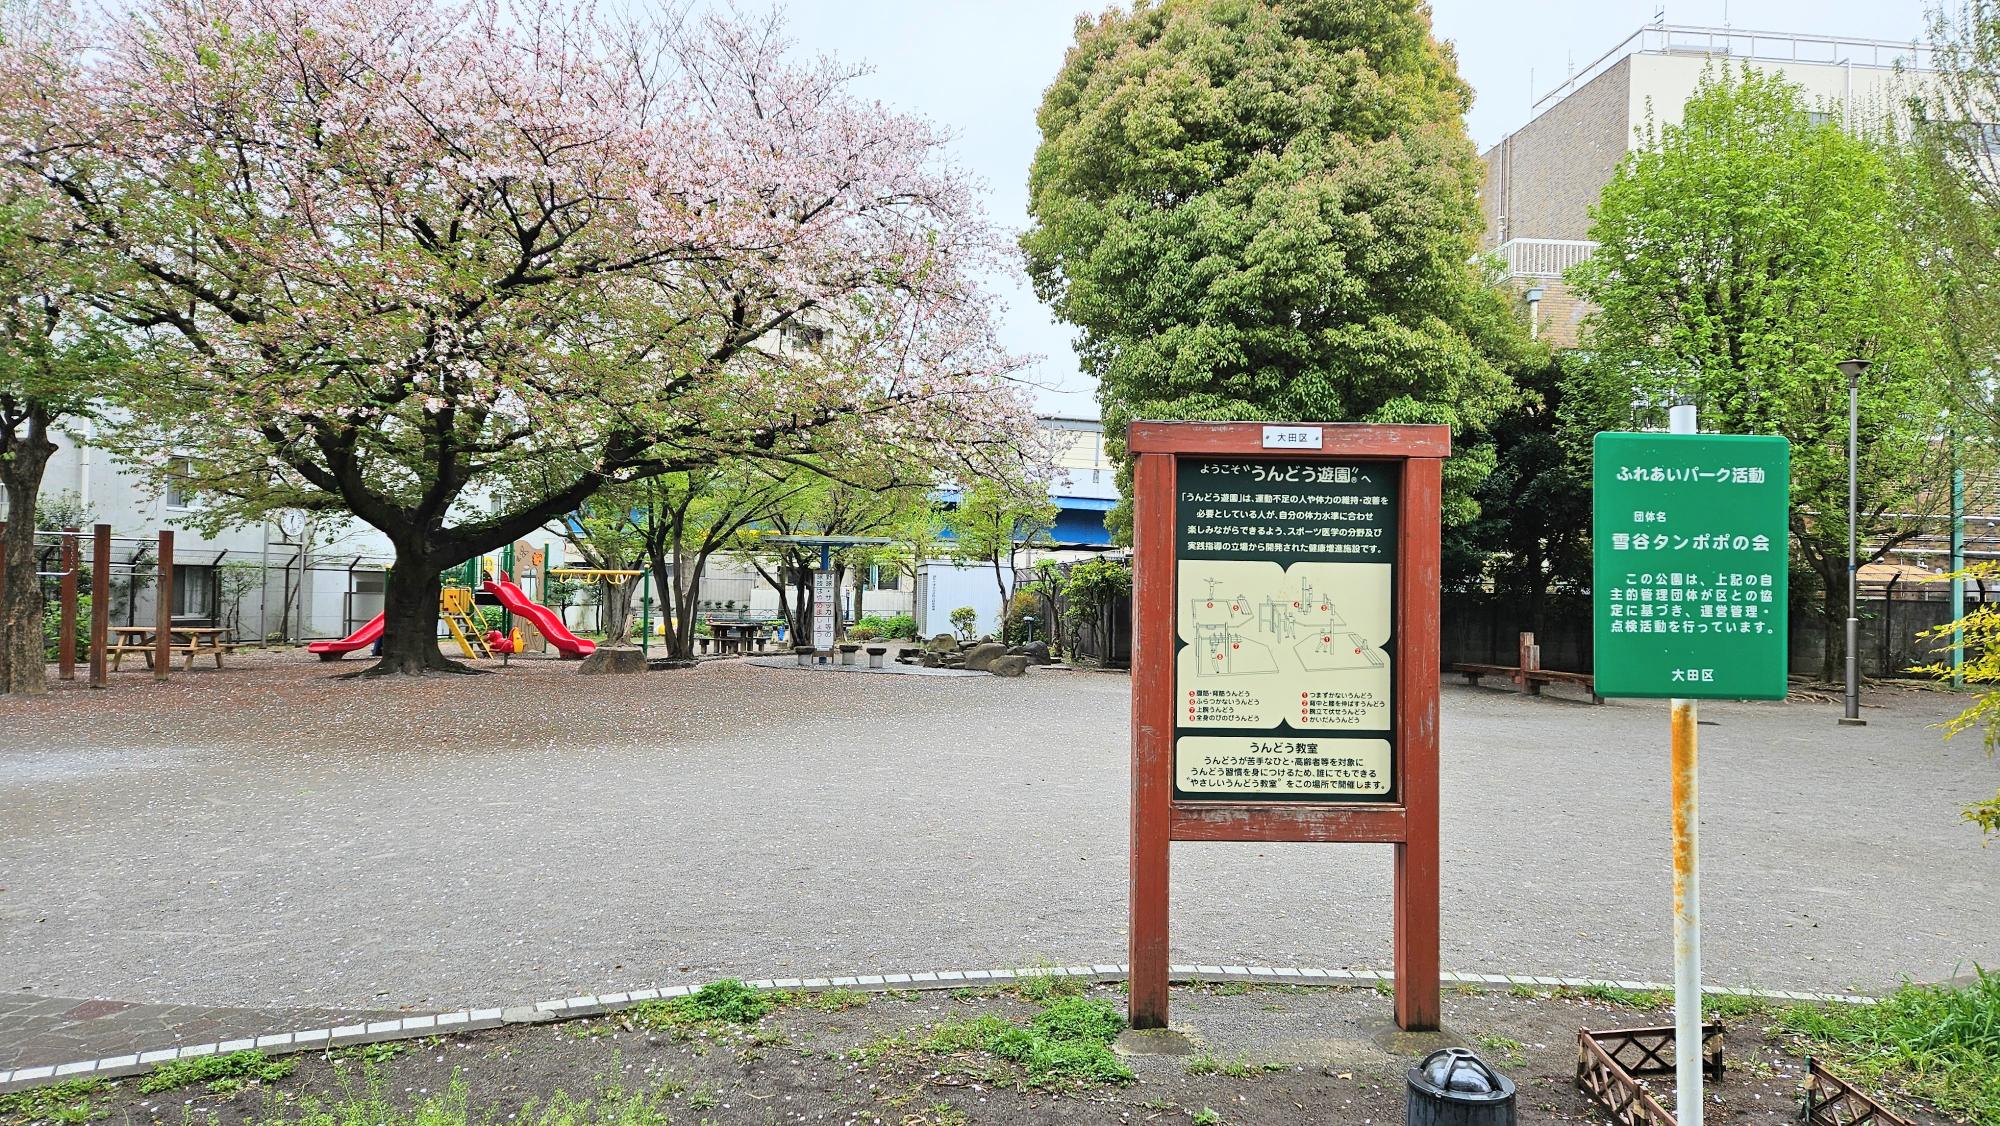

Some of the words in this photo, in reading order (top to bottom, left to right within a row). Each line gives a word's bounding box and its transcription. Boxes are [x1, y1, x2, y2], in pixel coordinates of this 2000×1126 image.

[1276, 433, 1308, 443] 大田区
[1617, 467, 1764, 483] ふれあいパーク活動
[1634, 511, 1666, 522] 団体名
[1612, 533, 1769, 551] 雪谷タンポポの会
[1626, 573, 1772, 586] この公園は、上記の自
[1610, 588, 1772, 602] 主的管理団体が区との協
[1611, 620, 1773, 634] 点検活動を行っています。
[1672, 669, 1714, 681] 大田区
[1250, 742, 1318, 754] うんどう教室
